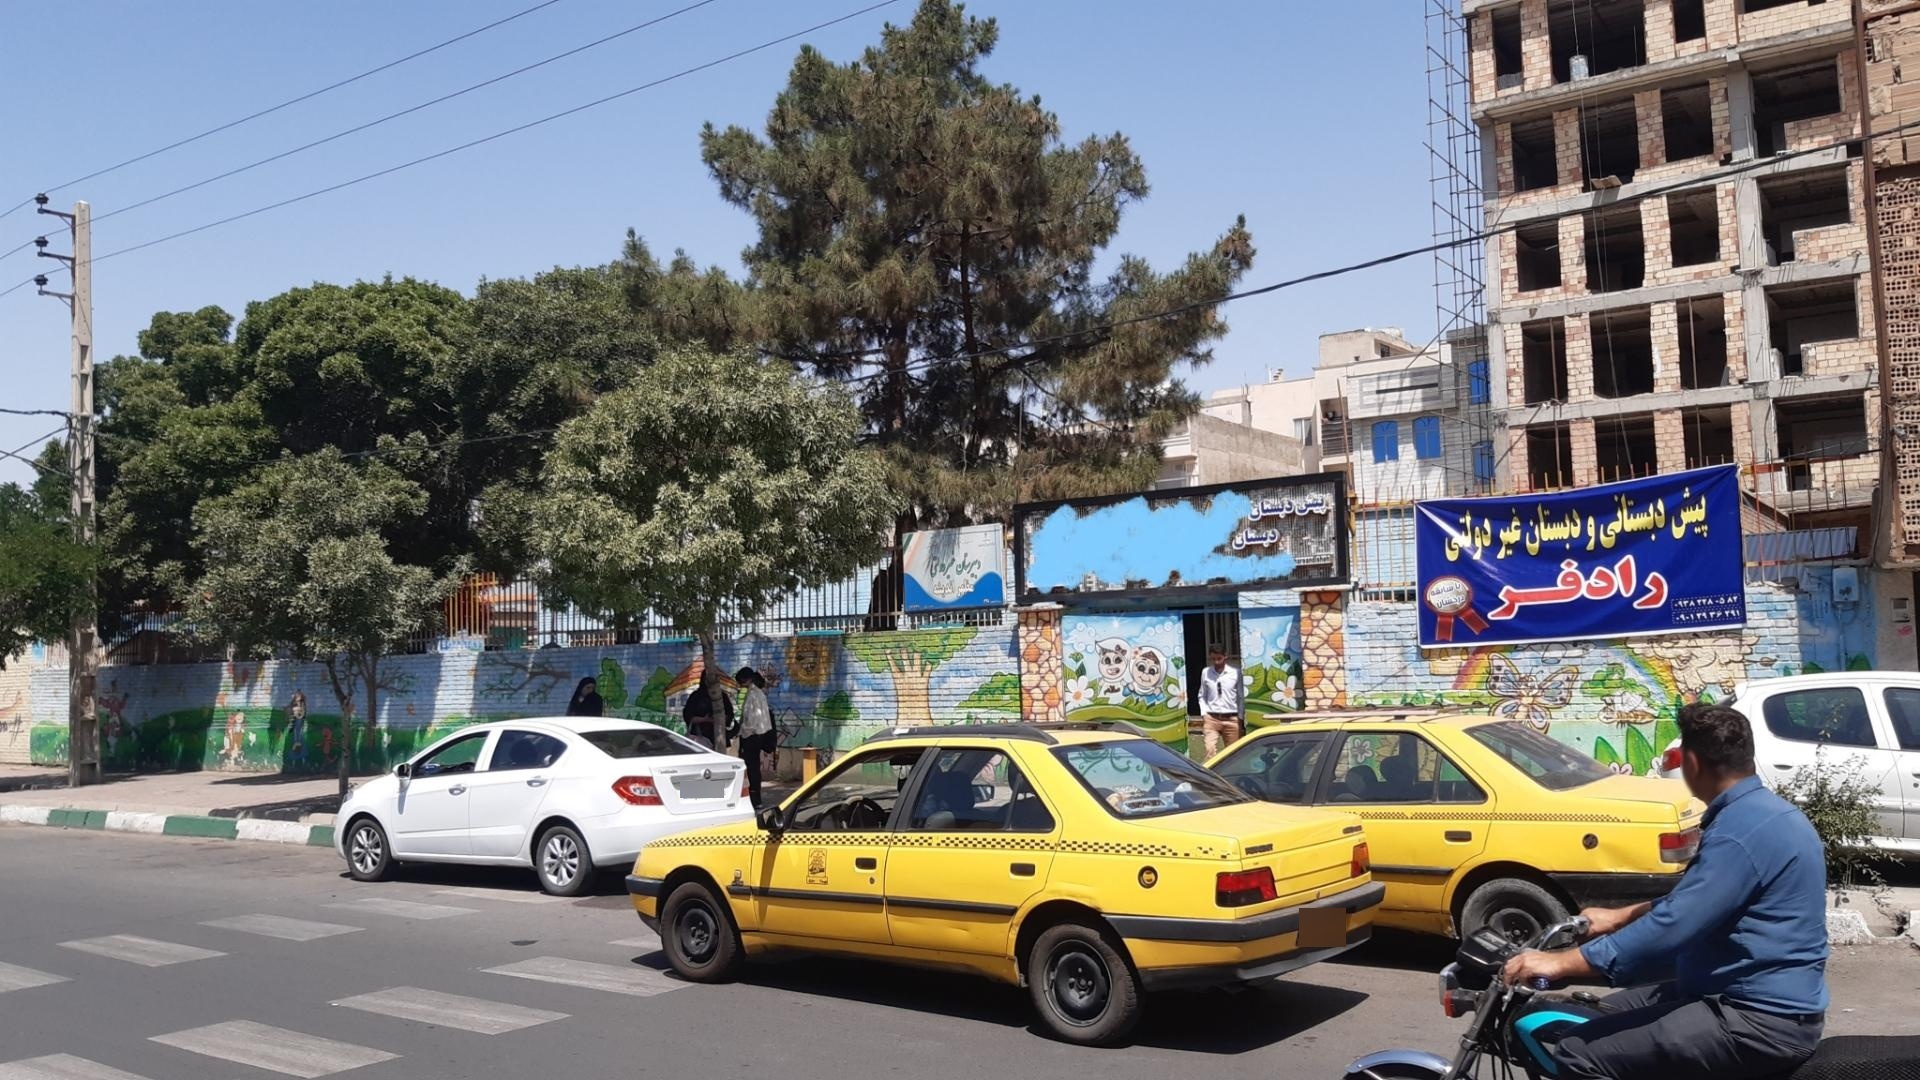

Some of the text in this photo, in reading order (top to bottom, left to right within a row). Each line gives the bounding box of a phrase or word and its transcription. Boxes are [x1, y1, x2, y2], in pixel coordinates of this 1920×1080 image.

[1296, 493, 1328, 515] پیش
[1445, 486, 1708, 562] پیش دبستانی و دبستان غیر دولتی
[1232, 527, 1280, 550] دبستان
[1488, 554, 1669, 620] رادفر
